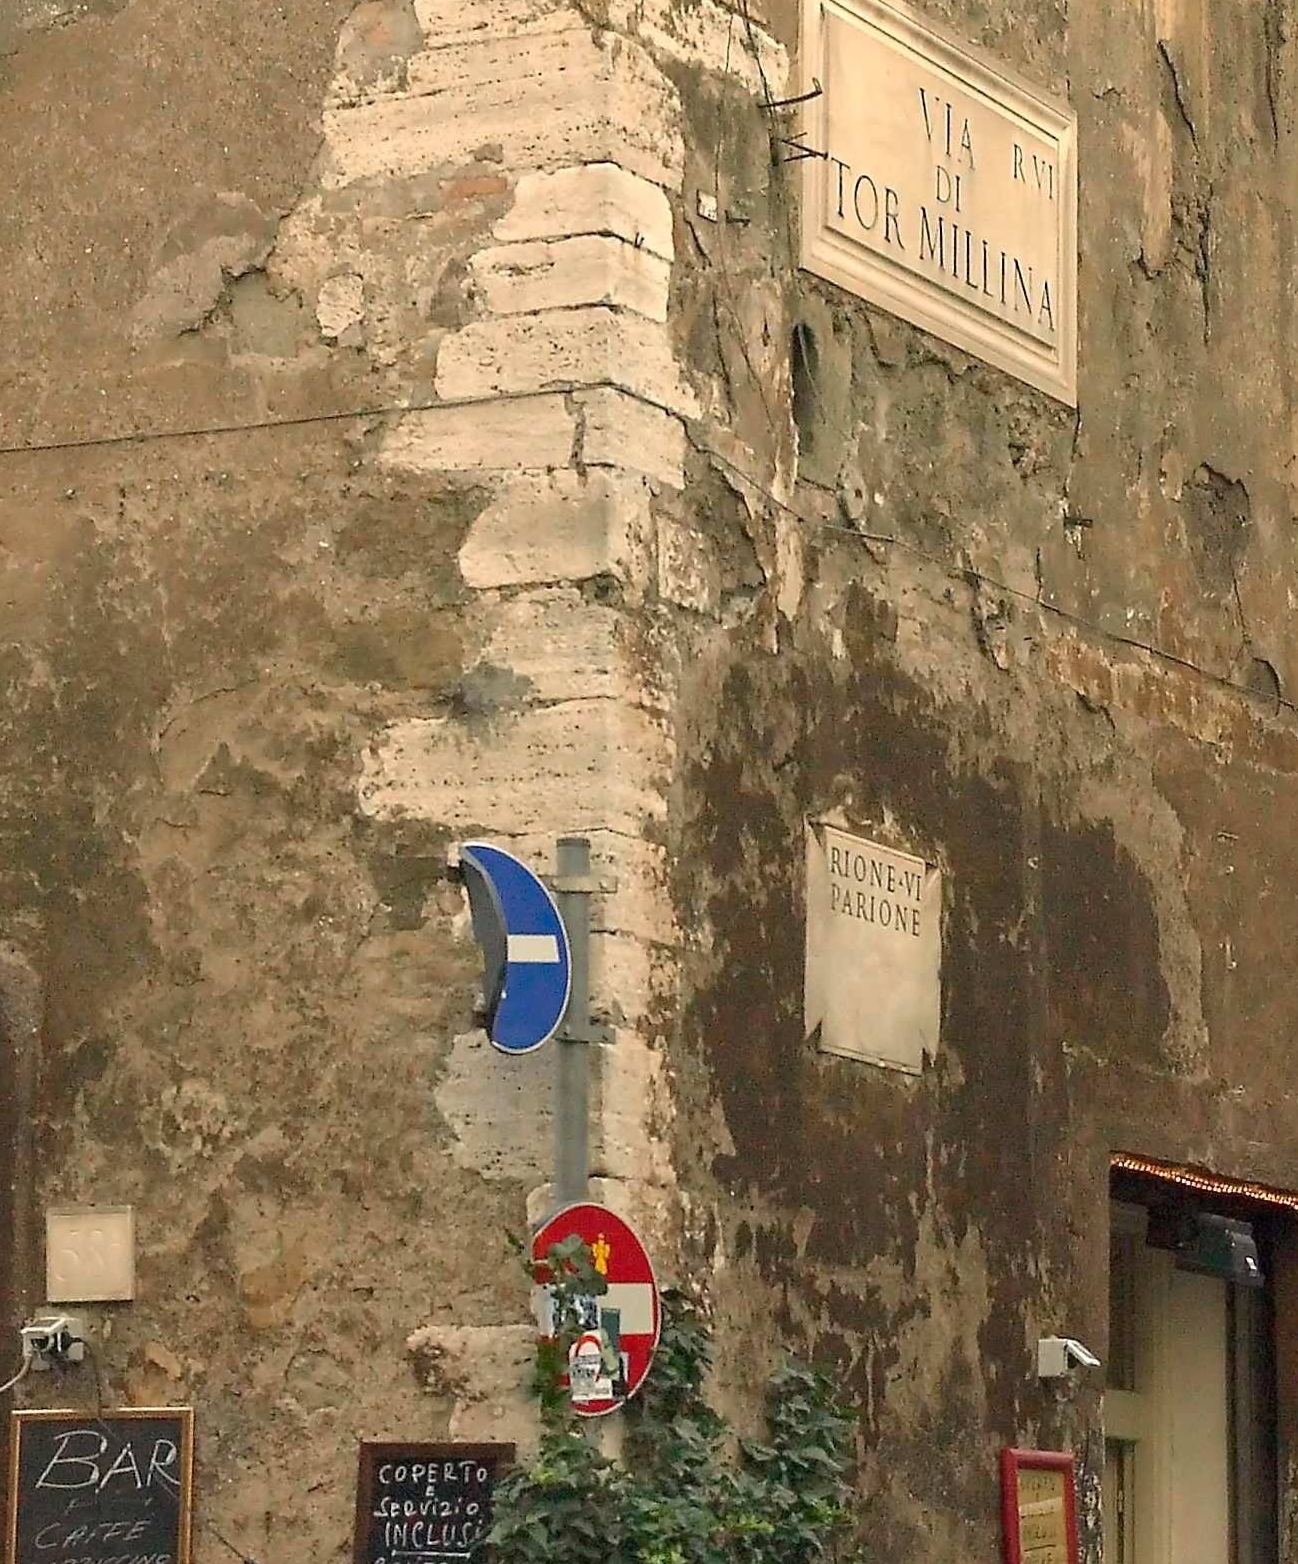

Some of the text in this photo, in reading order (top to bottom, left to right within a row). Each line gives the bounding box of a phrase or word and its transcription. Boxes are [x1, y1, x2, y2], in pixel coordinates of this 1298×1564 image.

[918, 86, 976, 171] VIA
[935, 164, 962, 213] DI
[831, 156, 1056, 333] TOR MILLINA
[829, 883, 921, 937] PARIONE
[34, 1430, 181, 1494] BAR
[378, 1460, 488, 1484] COPERTO
